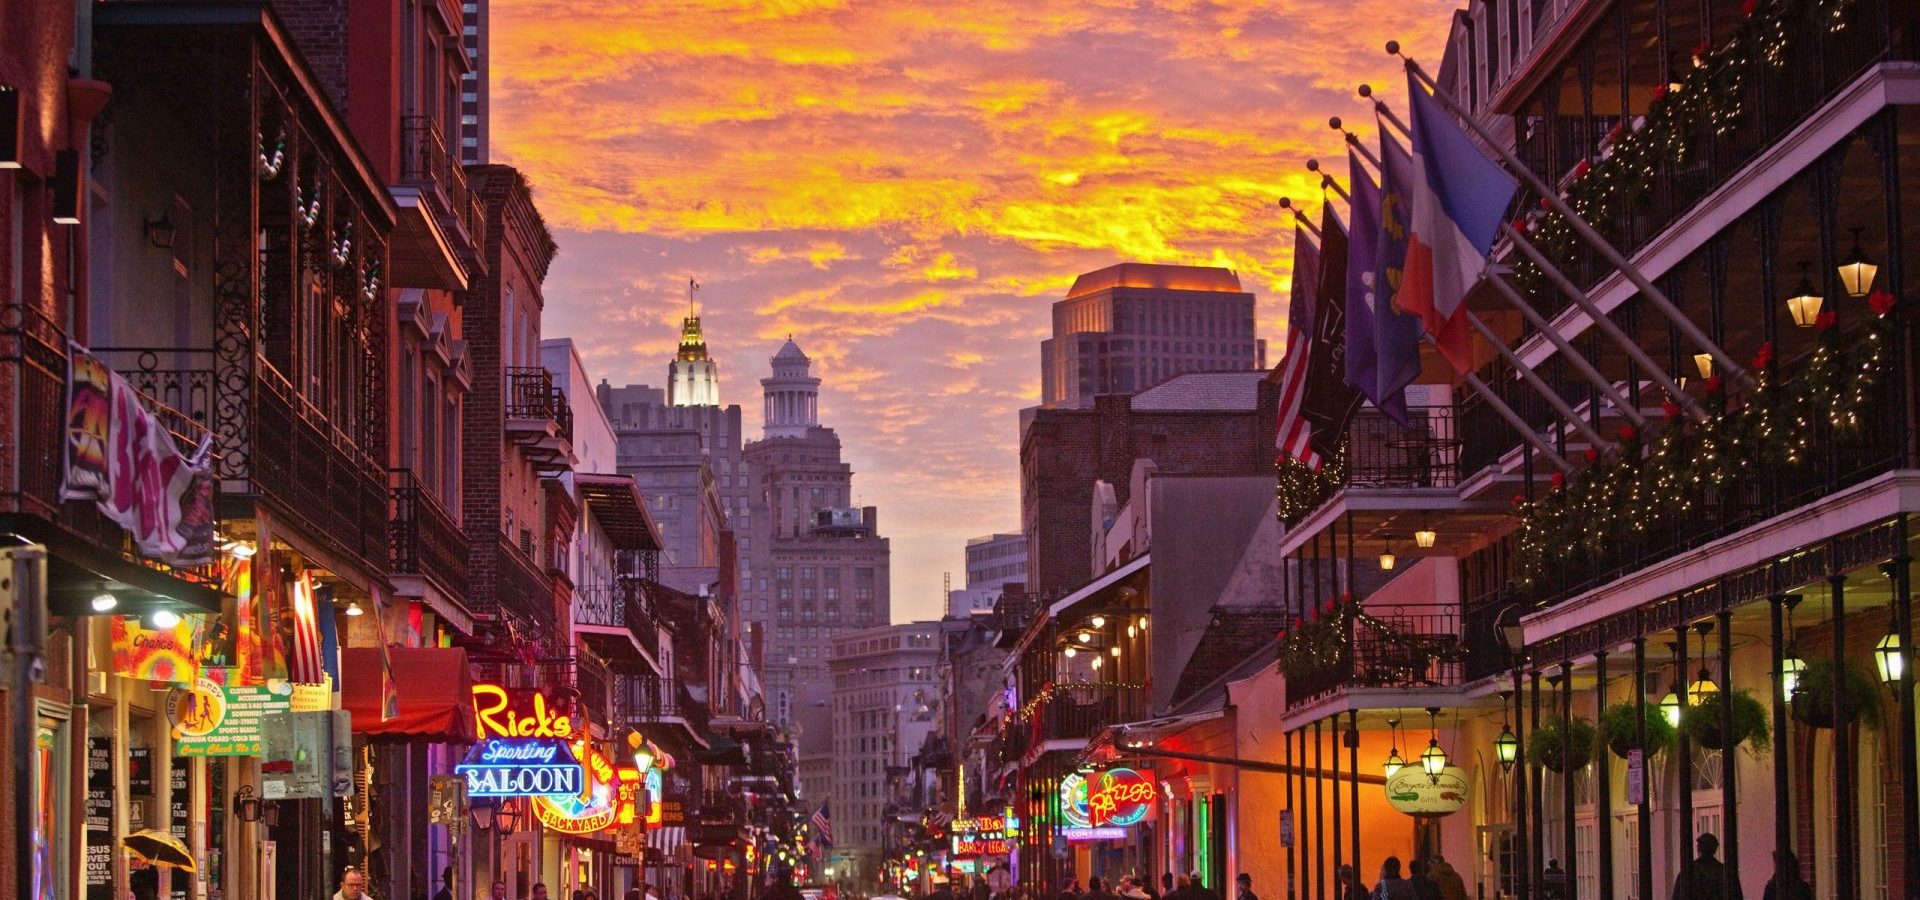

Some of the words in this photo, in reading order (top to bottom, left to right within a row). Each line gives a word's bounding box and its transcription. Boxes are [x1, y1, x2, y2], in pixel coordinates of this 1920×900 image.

[471, 684, 571, 739] Rick's
[482, 740, 557, 763] Sporting
[466, 768, 574, 793] SALOON
[542, 811, 573, 830] BACK
[577, 813, 607, 832] YARD
